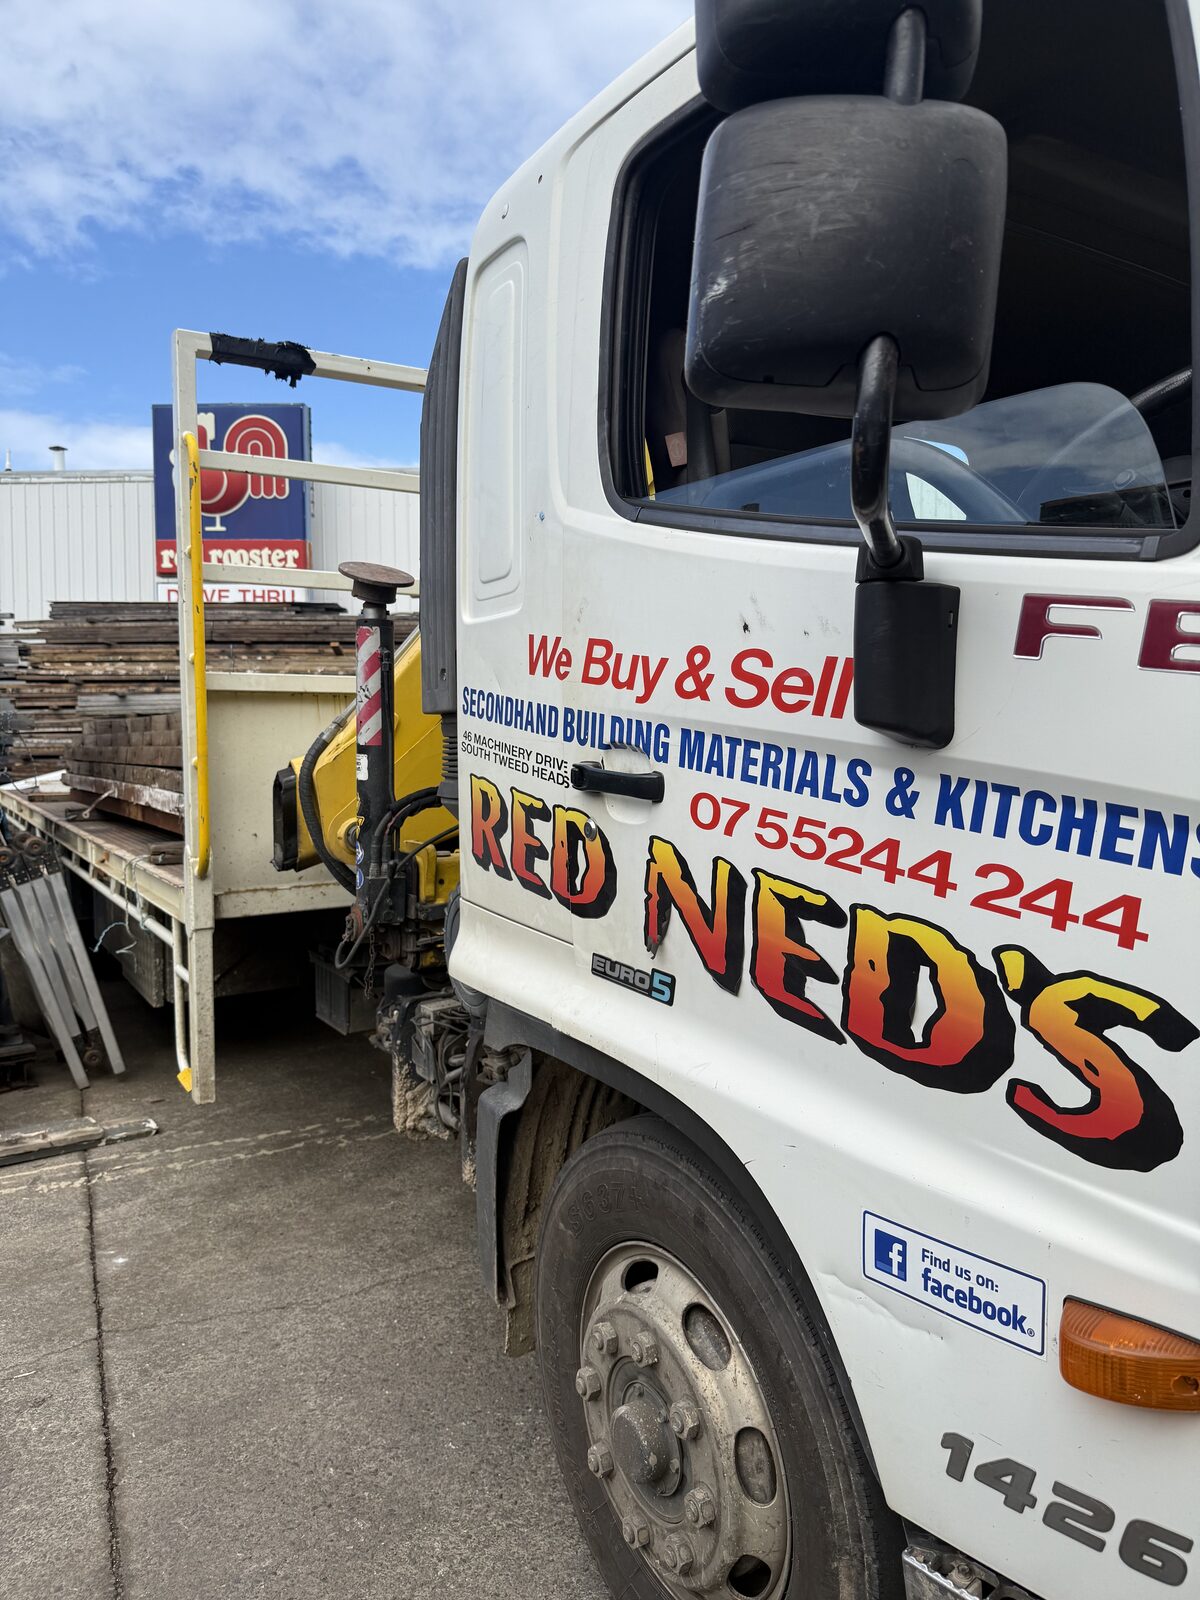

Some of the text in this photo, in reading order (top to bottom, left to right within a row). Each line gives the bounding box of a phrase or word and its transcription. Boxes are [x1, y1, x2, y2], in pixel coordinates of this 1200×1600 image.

[208, 547, 300, 568] rooster
[528, 634, 854, 719] We Buy & Sell
[461, 741, 569, 788] SOUTH TWEED HEADS
[462, 686, 1200, 882] SECONDHAND BUILDING MATERIALS & KITCHEN
[463, 730, 568, 774] 46 MACHINERY DRIVE
[470, 774, 617, 919] RED
[690, 792, 1149, 950] 07 55244 244
[644, 835, 1200, 1173] NED'S
[921, 1248, 999, 1293] Find us on:
[941, 1432, 1194, 1587] 1426
